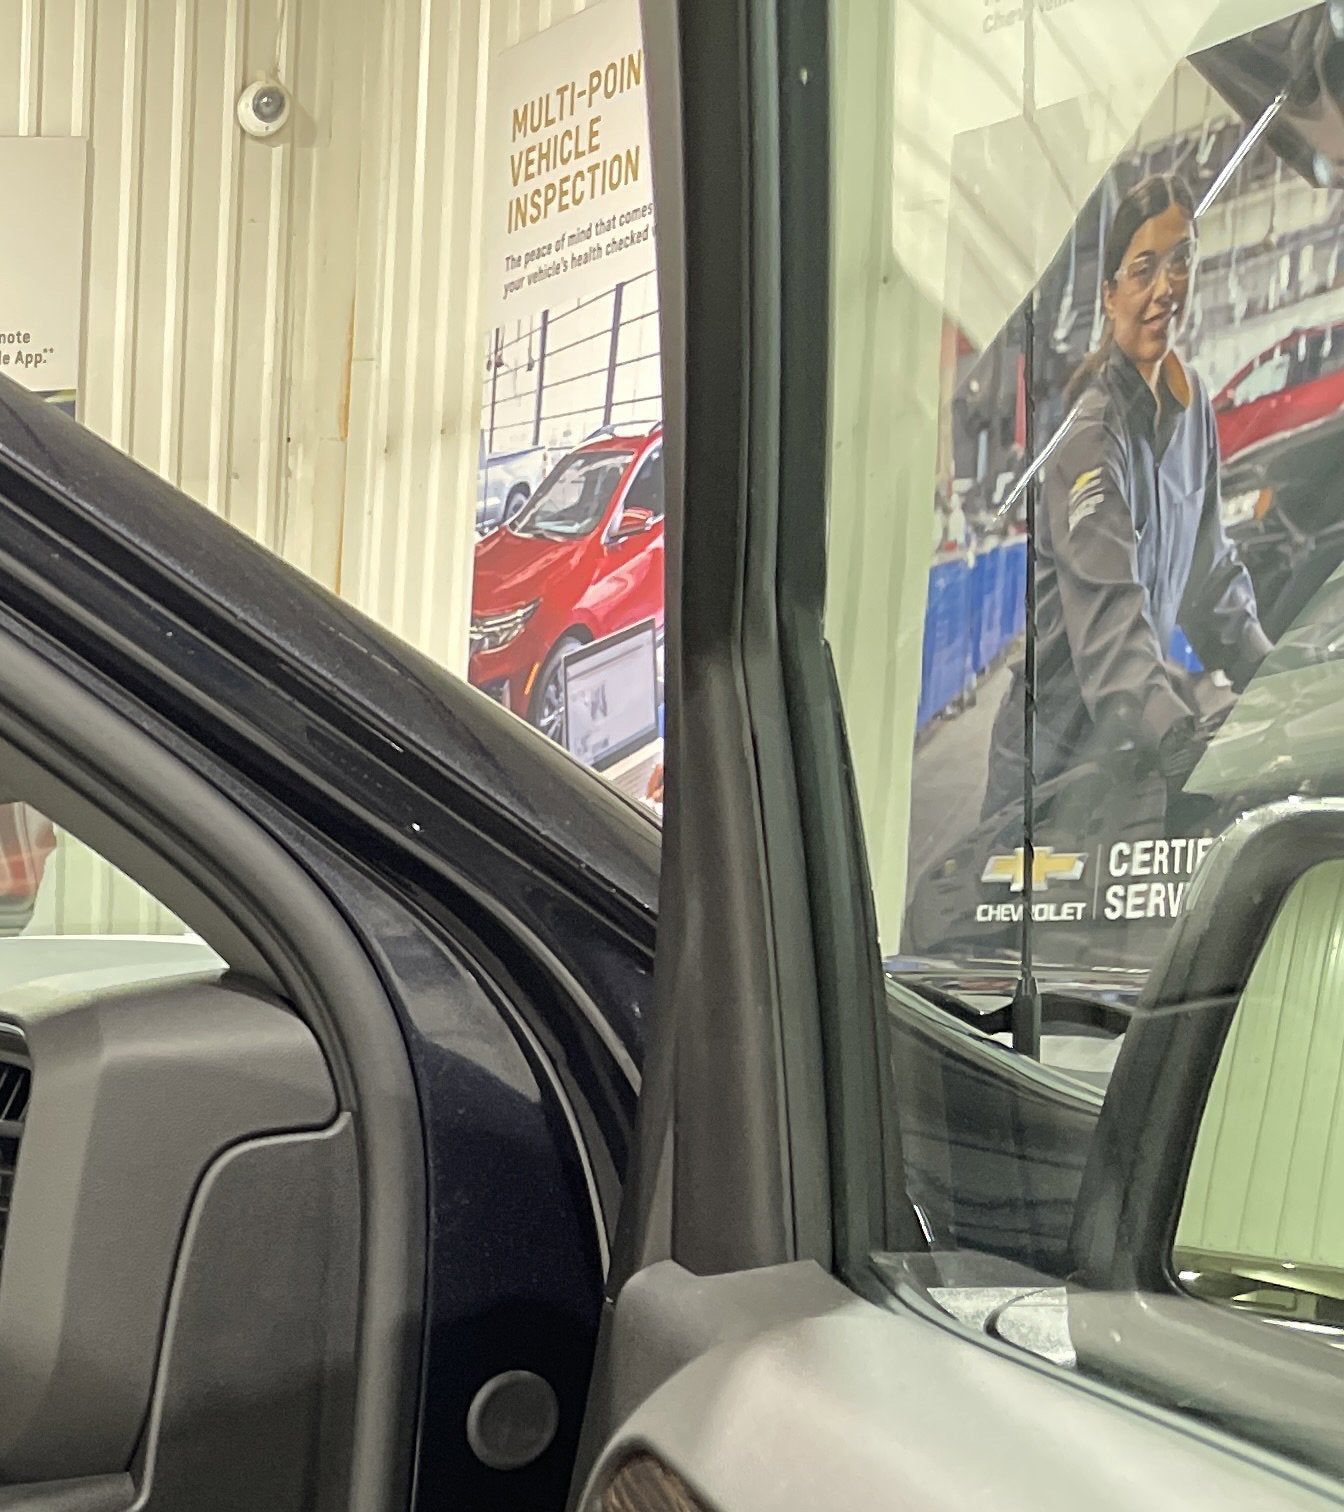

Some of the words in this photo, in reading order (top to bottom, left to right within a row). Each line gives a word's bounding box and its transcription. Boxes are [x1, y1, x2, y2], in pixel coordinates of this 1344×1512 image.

[512, 49, 642, 143] MULTI-POIN
[510, 115, 602, 187] VEHICLE
[507, 145, 641, 234] INSPECTION
[503, 276, 526, 299] your
[527, 257, 569, 285] vehicle's
[571, 243, 603, 269] health
[605, 224, 650, 256] checked
[505, 254, 522, 272] The
[524, 242, 553, 269] peace
[554, 230, 566, 252] of
[567, 222, 593, 247] mind
[595, 214, 616, 236] that
[619, 202, 653, 227] comes
[1109, 837, 1213, 877] CERTIF
[976, 902, 1087, 922] CHEVOLET
[1104, 882, 1187, 920] SERV
